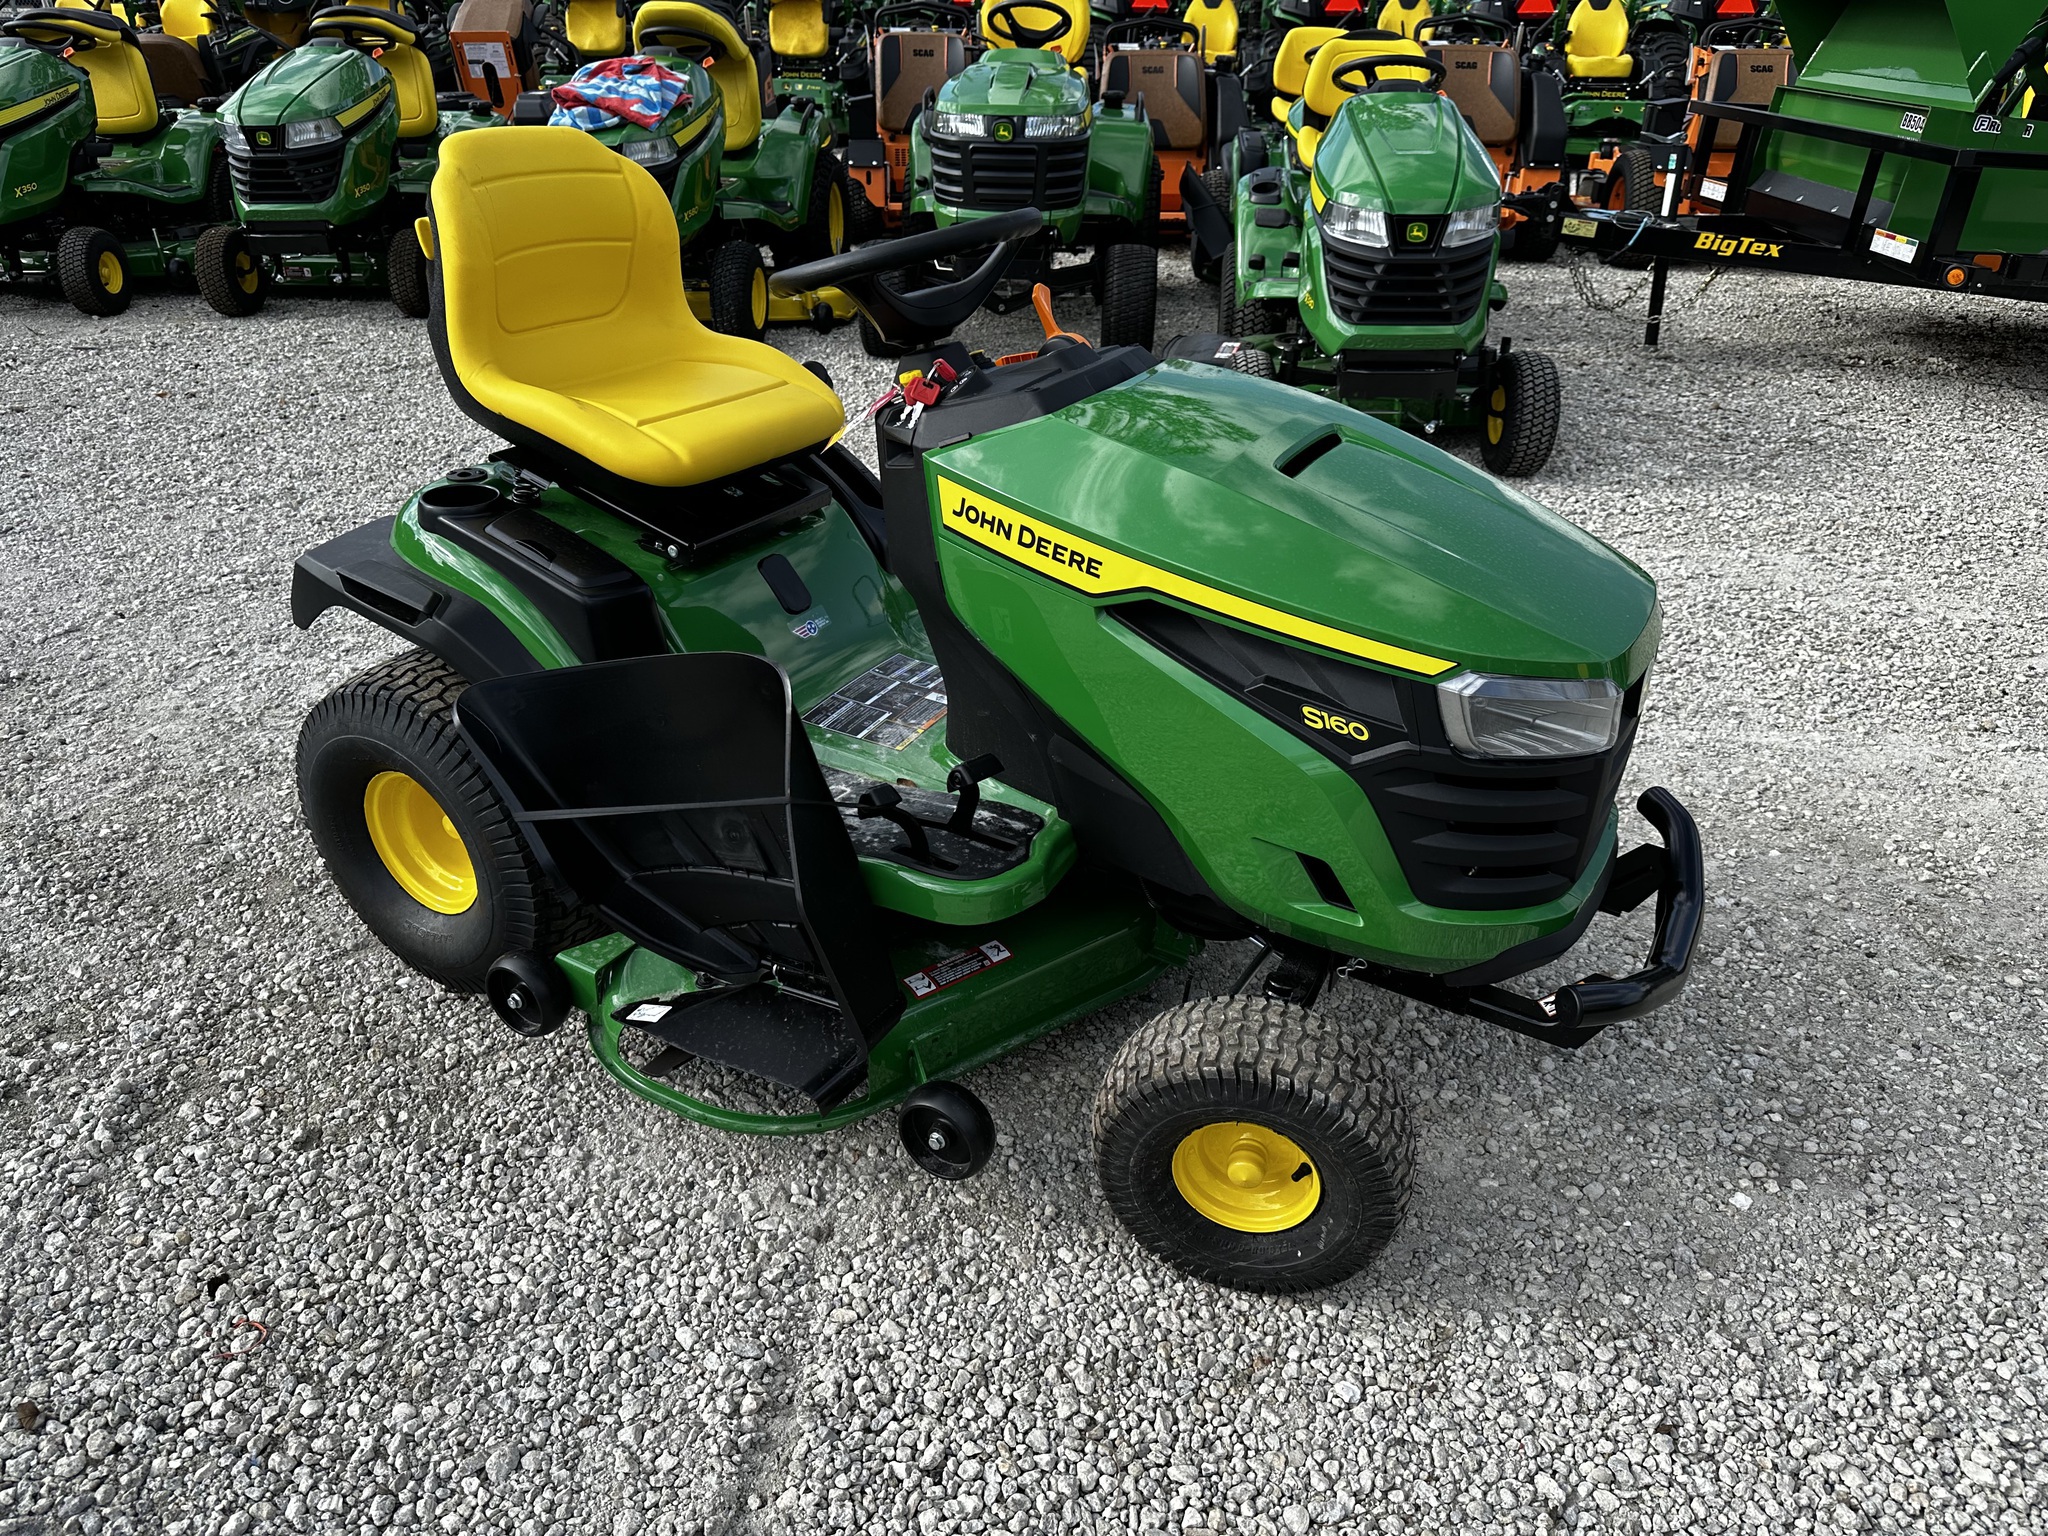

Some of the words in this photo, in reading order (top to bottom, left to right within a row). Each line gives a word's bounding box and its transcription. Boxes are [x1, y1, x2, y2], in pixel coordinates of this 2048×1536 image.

[912, 49, 934, 57] SCAG
[1142, 66, 1164, 74] SCAG
[1455, 61, 1478, 69] SCAG
[1750, 64, 1773, 73] SCAG
[44, 95, 58, 107] JOHN
[56, 88, 71, 101] DEERE
[1901, 113, 1926, 132] BB504
[14, 182, 38, 198] X350
[1693, 231, 1784, 258] BigTex
[952, 497, 1013, 541] JOHN
[1017, 524, 1103, 579] DEERE
[1302, 705, 1369, 741] S160
